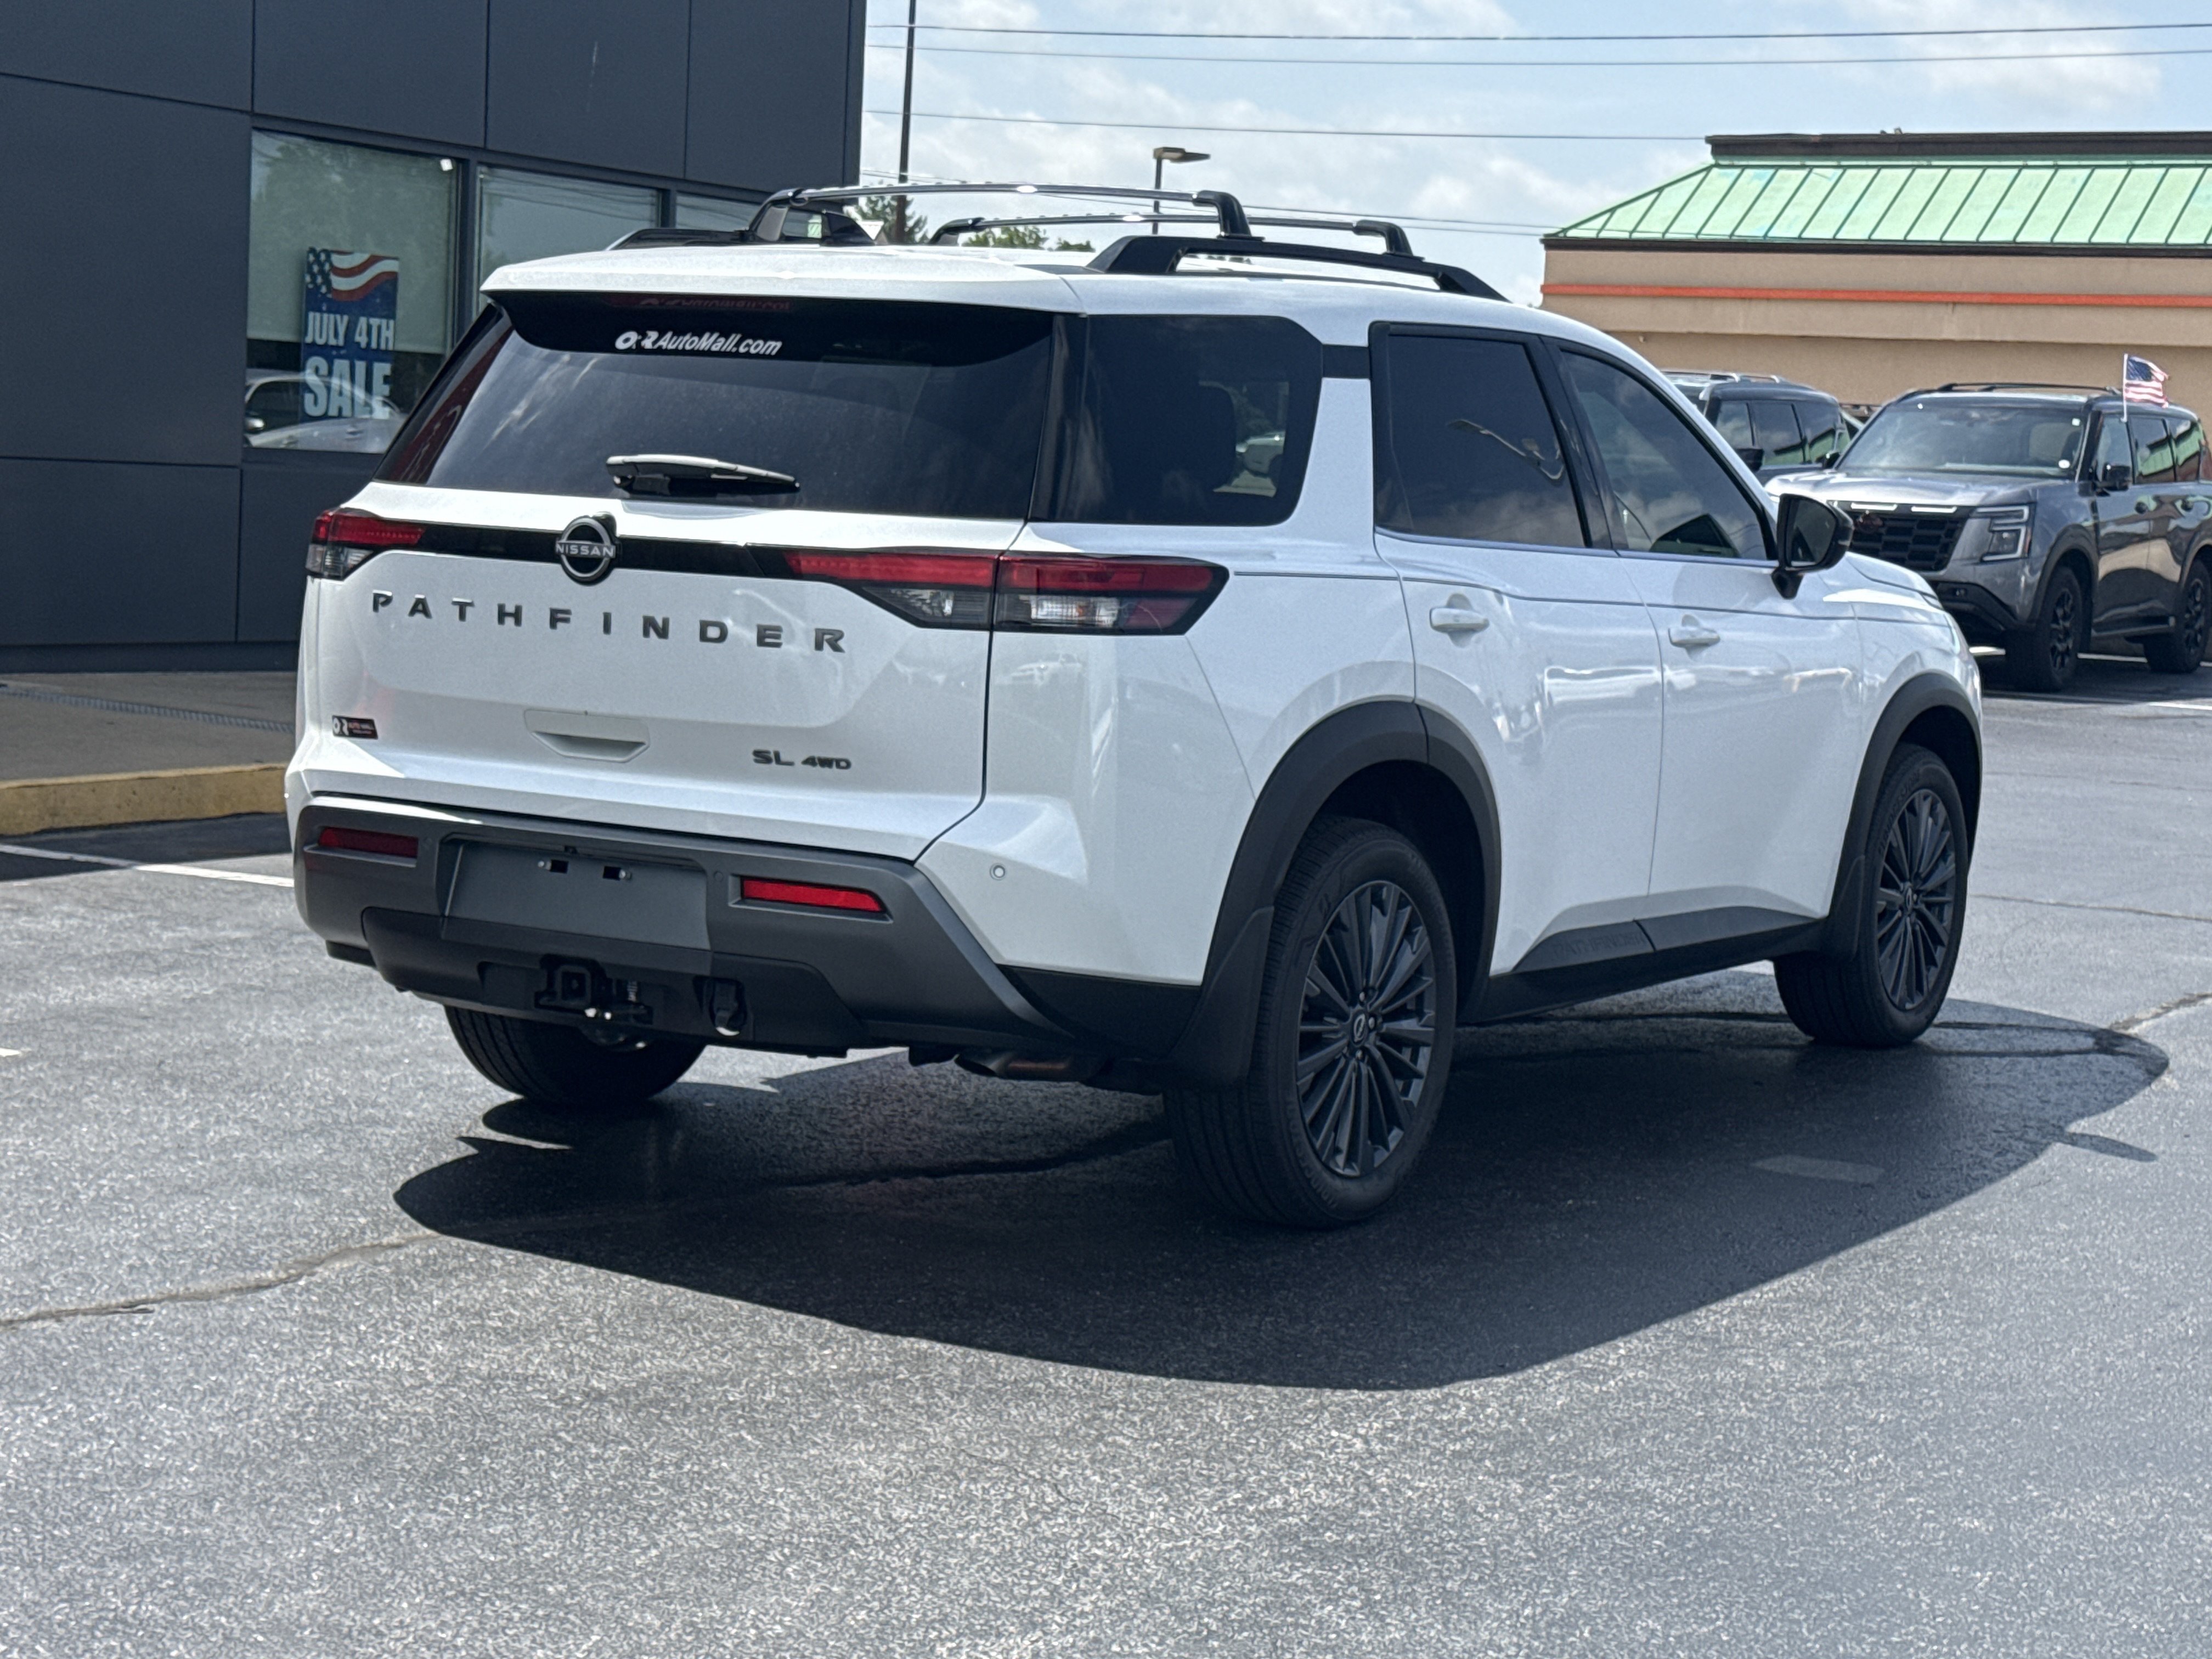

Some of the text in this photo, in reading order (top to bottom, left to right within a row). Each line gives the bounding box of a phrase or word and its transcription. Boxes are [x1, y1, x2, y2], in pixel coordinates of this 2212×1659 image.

[304, 311, 395, 351] JULY 4TH
[304, 356, 392, 420] SALE
[555, 542, 614, 557] NISSAN
[371, 590, 845, 653] PATHFINDER
[752, 749, 852, 770] SL 4WD
